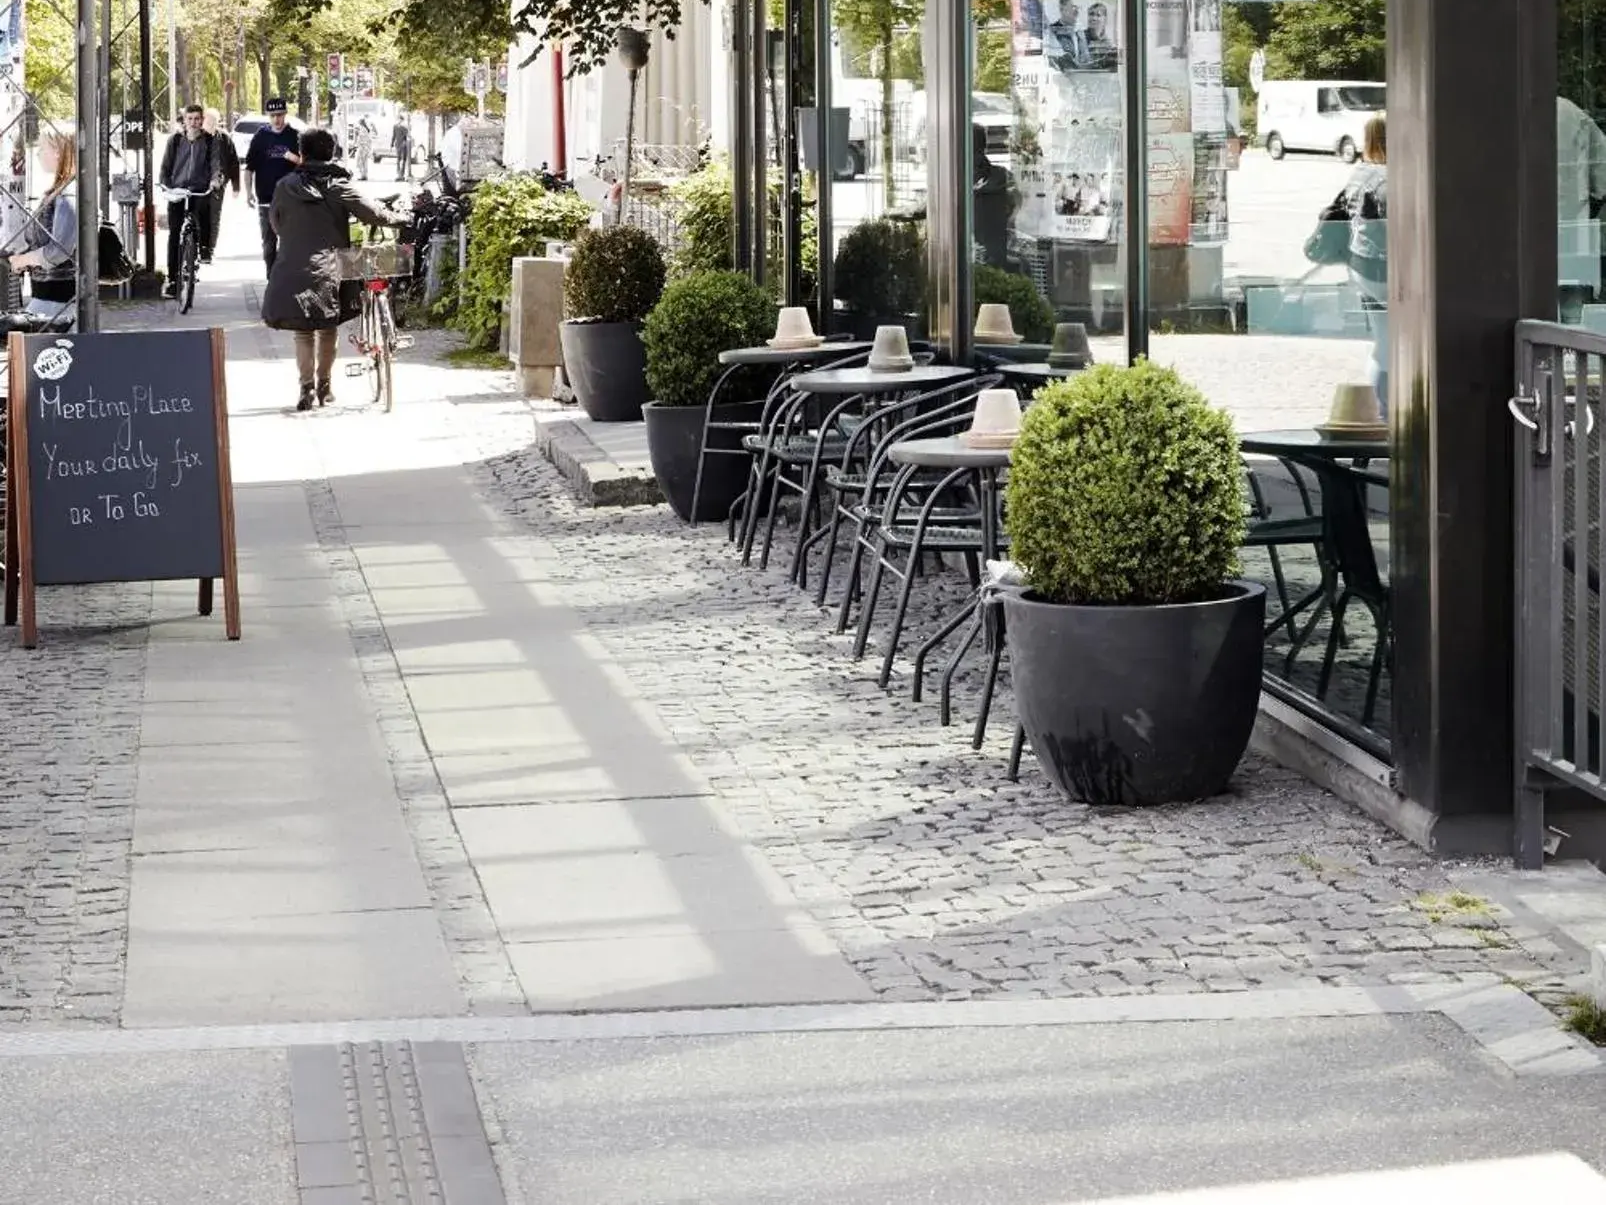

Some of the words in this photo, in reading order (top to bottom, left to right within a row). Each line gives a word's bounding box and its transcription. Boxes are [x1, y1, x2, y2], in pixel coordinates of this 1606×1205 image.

[124, 121, 144, 133] OPE
[38, 352, 69, 374] Wi-Fi
[39, 385, 131, 451] Meeting
[102, 439, 158, 489] daily
[98, 494, 124, 520] To
[132, 491, 160, 517] Go
